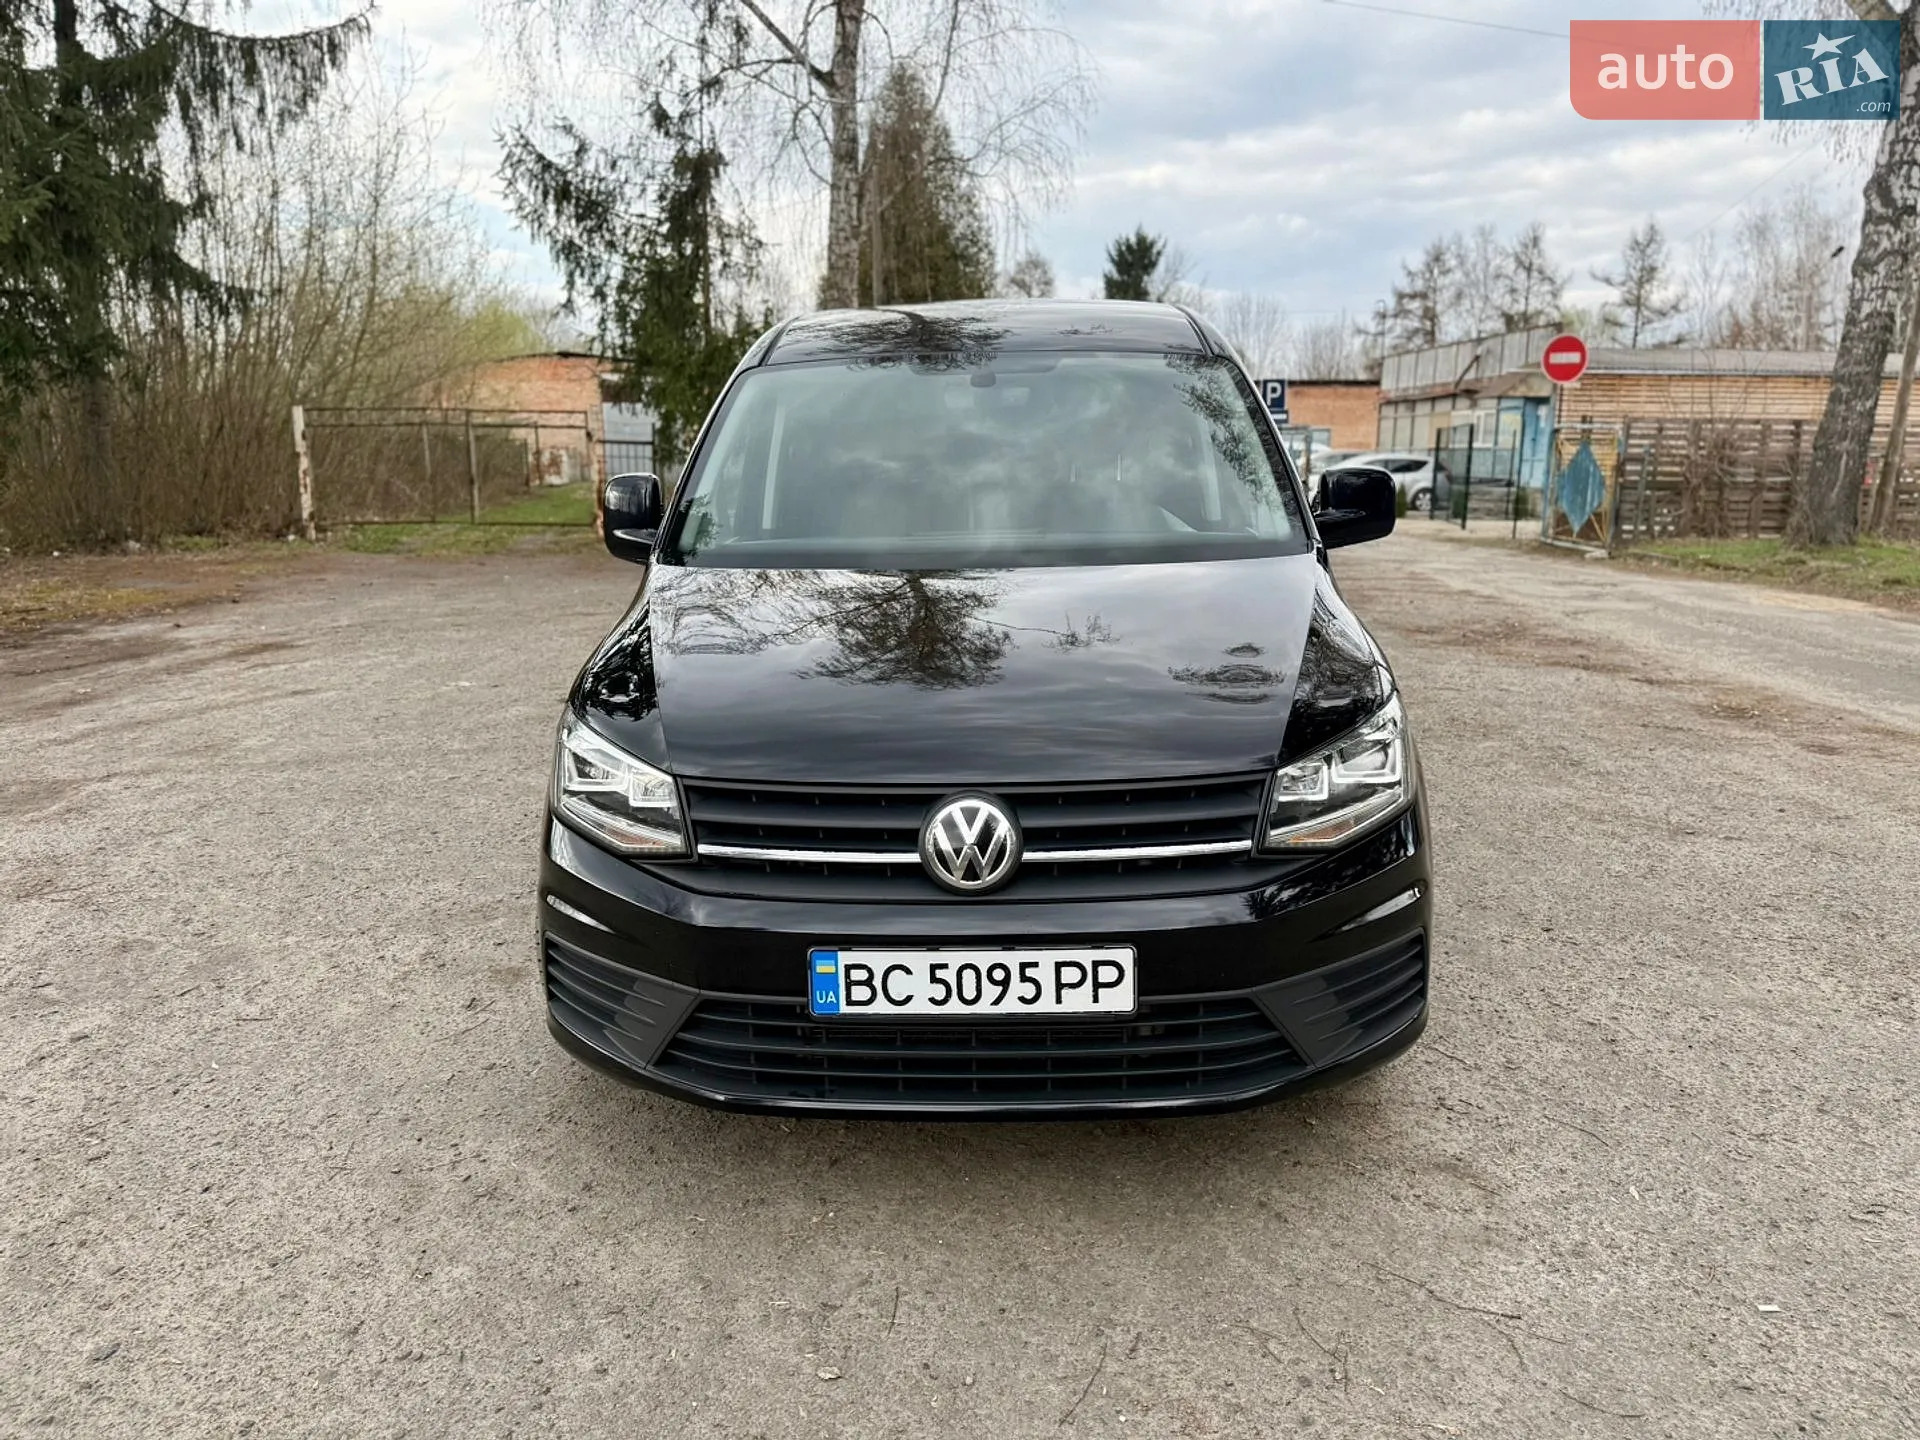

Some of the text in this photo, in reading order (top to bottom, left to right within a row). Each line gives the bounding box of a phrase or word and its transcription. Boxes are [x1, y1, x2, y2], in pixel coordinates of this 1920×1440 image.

[1266, 382, 1282, 406] P
[844, 960, 1126, 1007] BC 5095 PP
[816, 990, 837, 1005] UA
